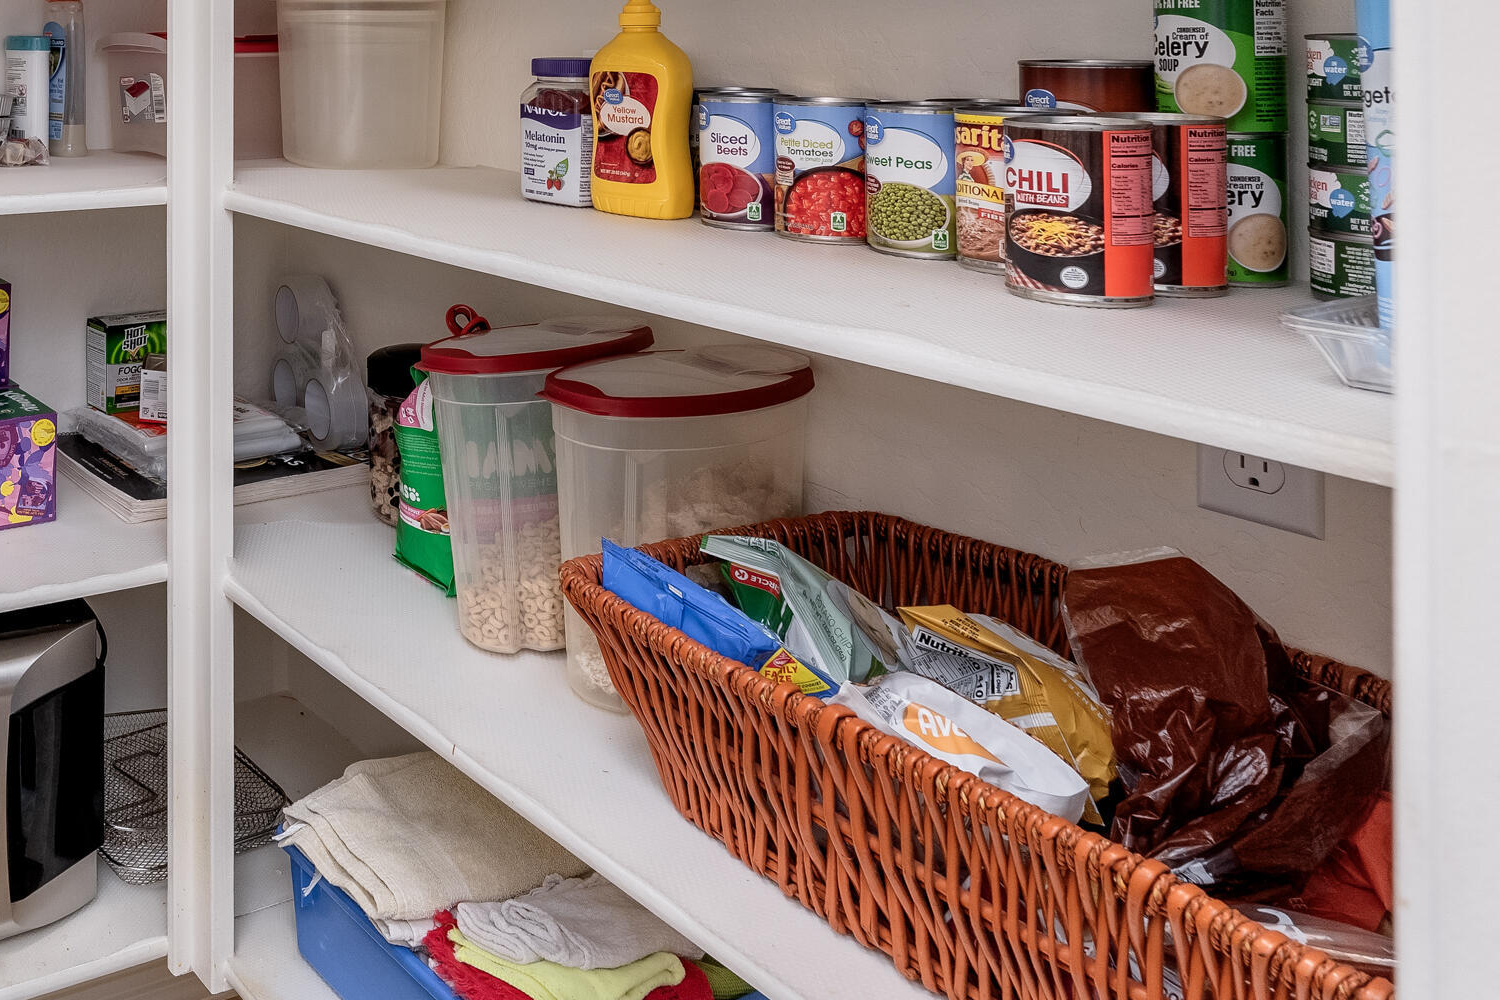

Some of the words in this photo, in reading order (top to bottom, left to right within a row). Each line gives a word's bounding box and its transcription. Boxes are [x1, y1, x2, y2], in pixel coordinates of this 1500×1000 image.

[1255, 0, 1282, 8] Nutrition
[1255, 8, 1275, 17] Facts
[1171, 32, 1197, 41] Cream
[1199, 32, 1210, 40] of
[1158, 58, 1179, 72] SOUP
[1324, 66, 1348, 74] water
[1027, 94, 1050, 104] Great
[611, 105, 637, 114] Yellow
[607, 113, 644, 125] Mustard
[775, 116, 792, 126] Great
[524, 130, 565, 145] Melatonin
[710, 132, 748, 145] Sliced
[780, 137, 801, 148] Petite
[802, 139, 834, 150] Diced
[716, 144, 749, 156] Beets
[786, 147, 834, 158] Tomatoes
[1231, 145, 1257, 157] FREE
[895, 156, 933, 170] Peas
[1005, 166, 1069, 194] CHILI
[1255, 181, 1264, 190] of
[1016, 191, 1035, 203] WITH
[1036, 192, 1067, 204] BEANS
[1330, 199, 1354, 207] water
[125, 326, 146, 340] HOT
[122, 336, 149, 351] SHOT
[815, 590, 836, 629] POTATO
